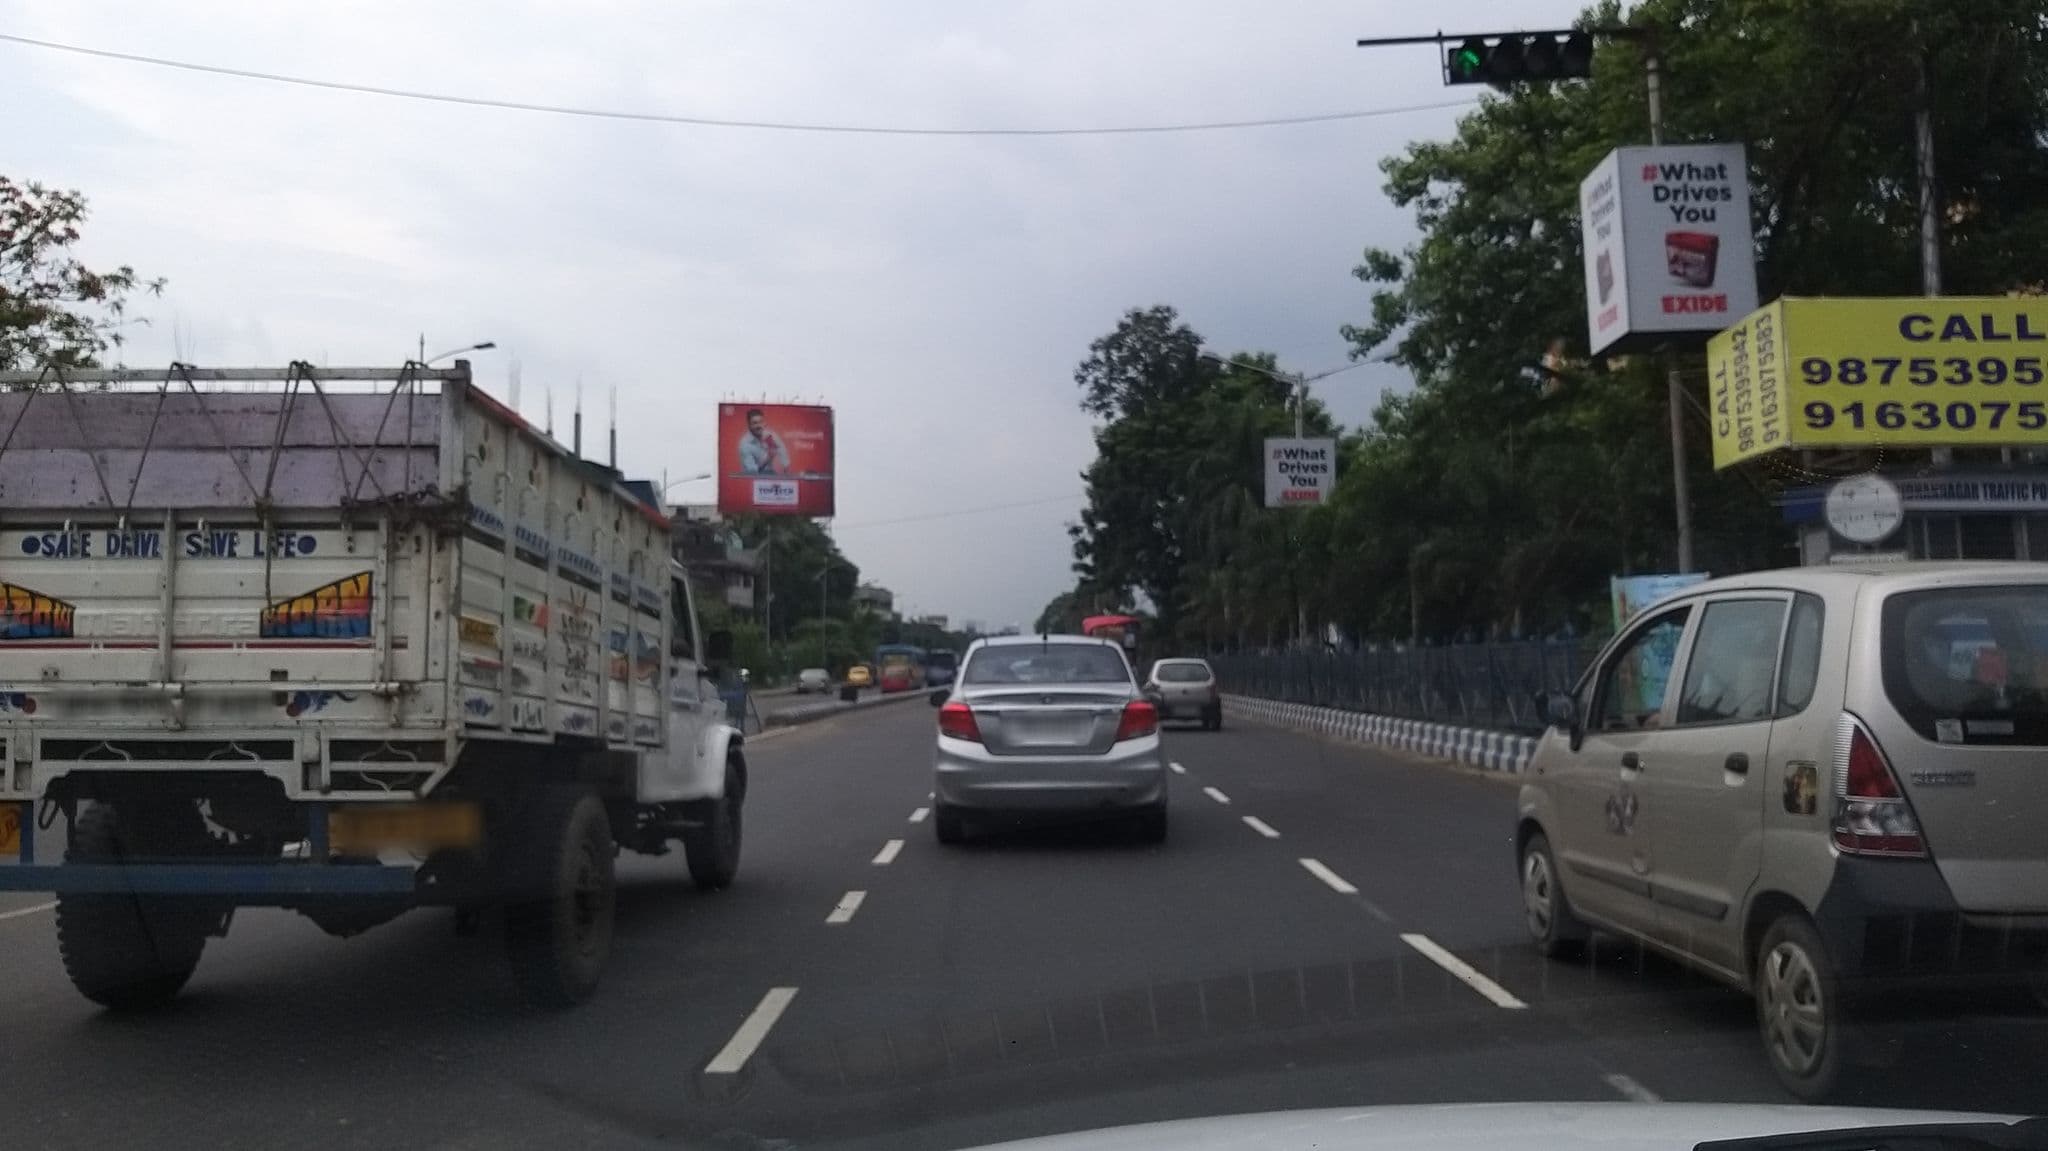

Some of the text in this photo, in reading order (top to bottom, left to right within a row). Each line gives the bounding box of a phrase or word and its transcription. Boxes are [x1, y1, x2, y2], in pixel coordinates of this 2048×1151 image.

[1642, 161, 1727, 181] #What
[1653, 184, 1732, 203] Drives
[1670, 205, 1716, 223] You
[1662, 294, 1728, 313] EXIDE
[1899, 313, 2047, 342] CALL
[1801, 357, 2048, 386] 9875395
[1717, 359, 1729, 437] CALL
[1279, 461, 1328, 473] Drives
[1288, 475, 1317, 487] You
[1983, 482, 2029, 500] TRAFFIC
[254, 532, 296, 557] LFE
